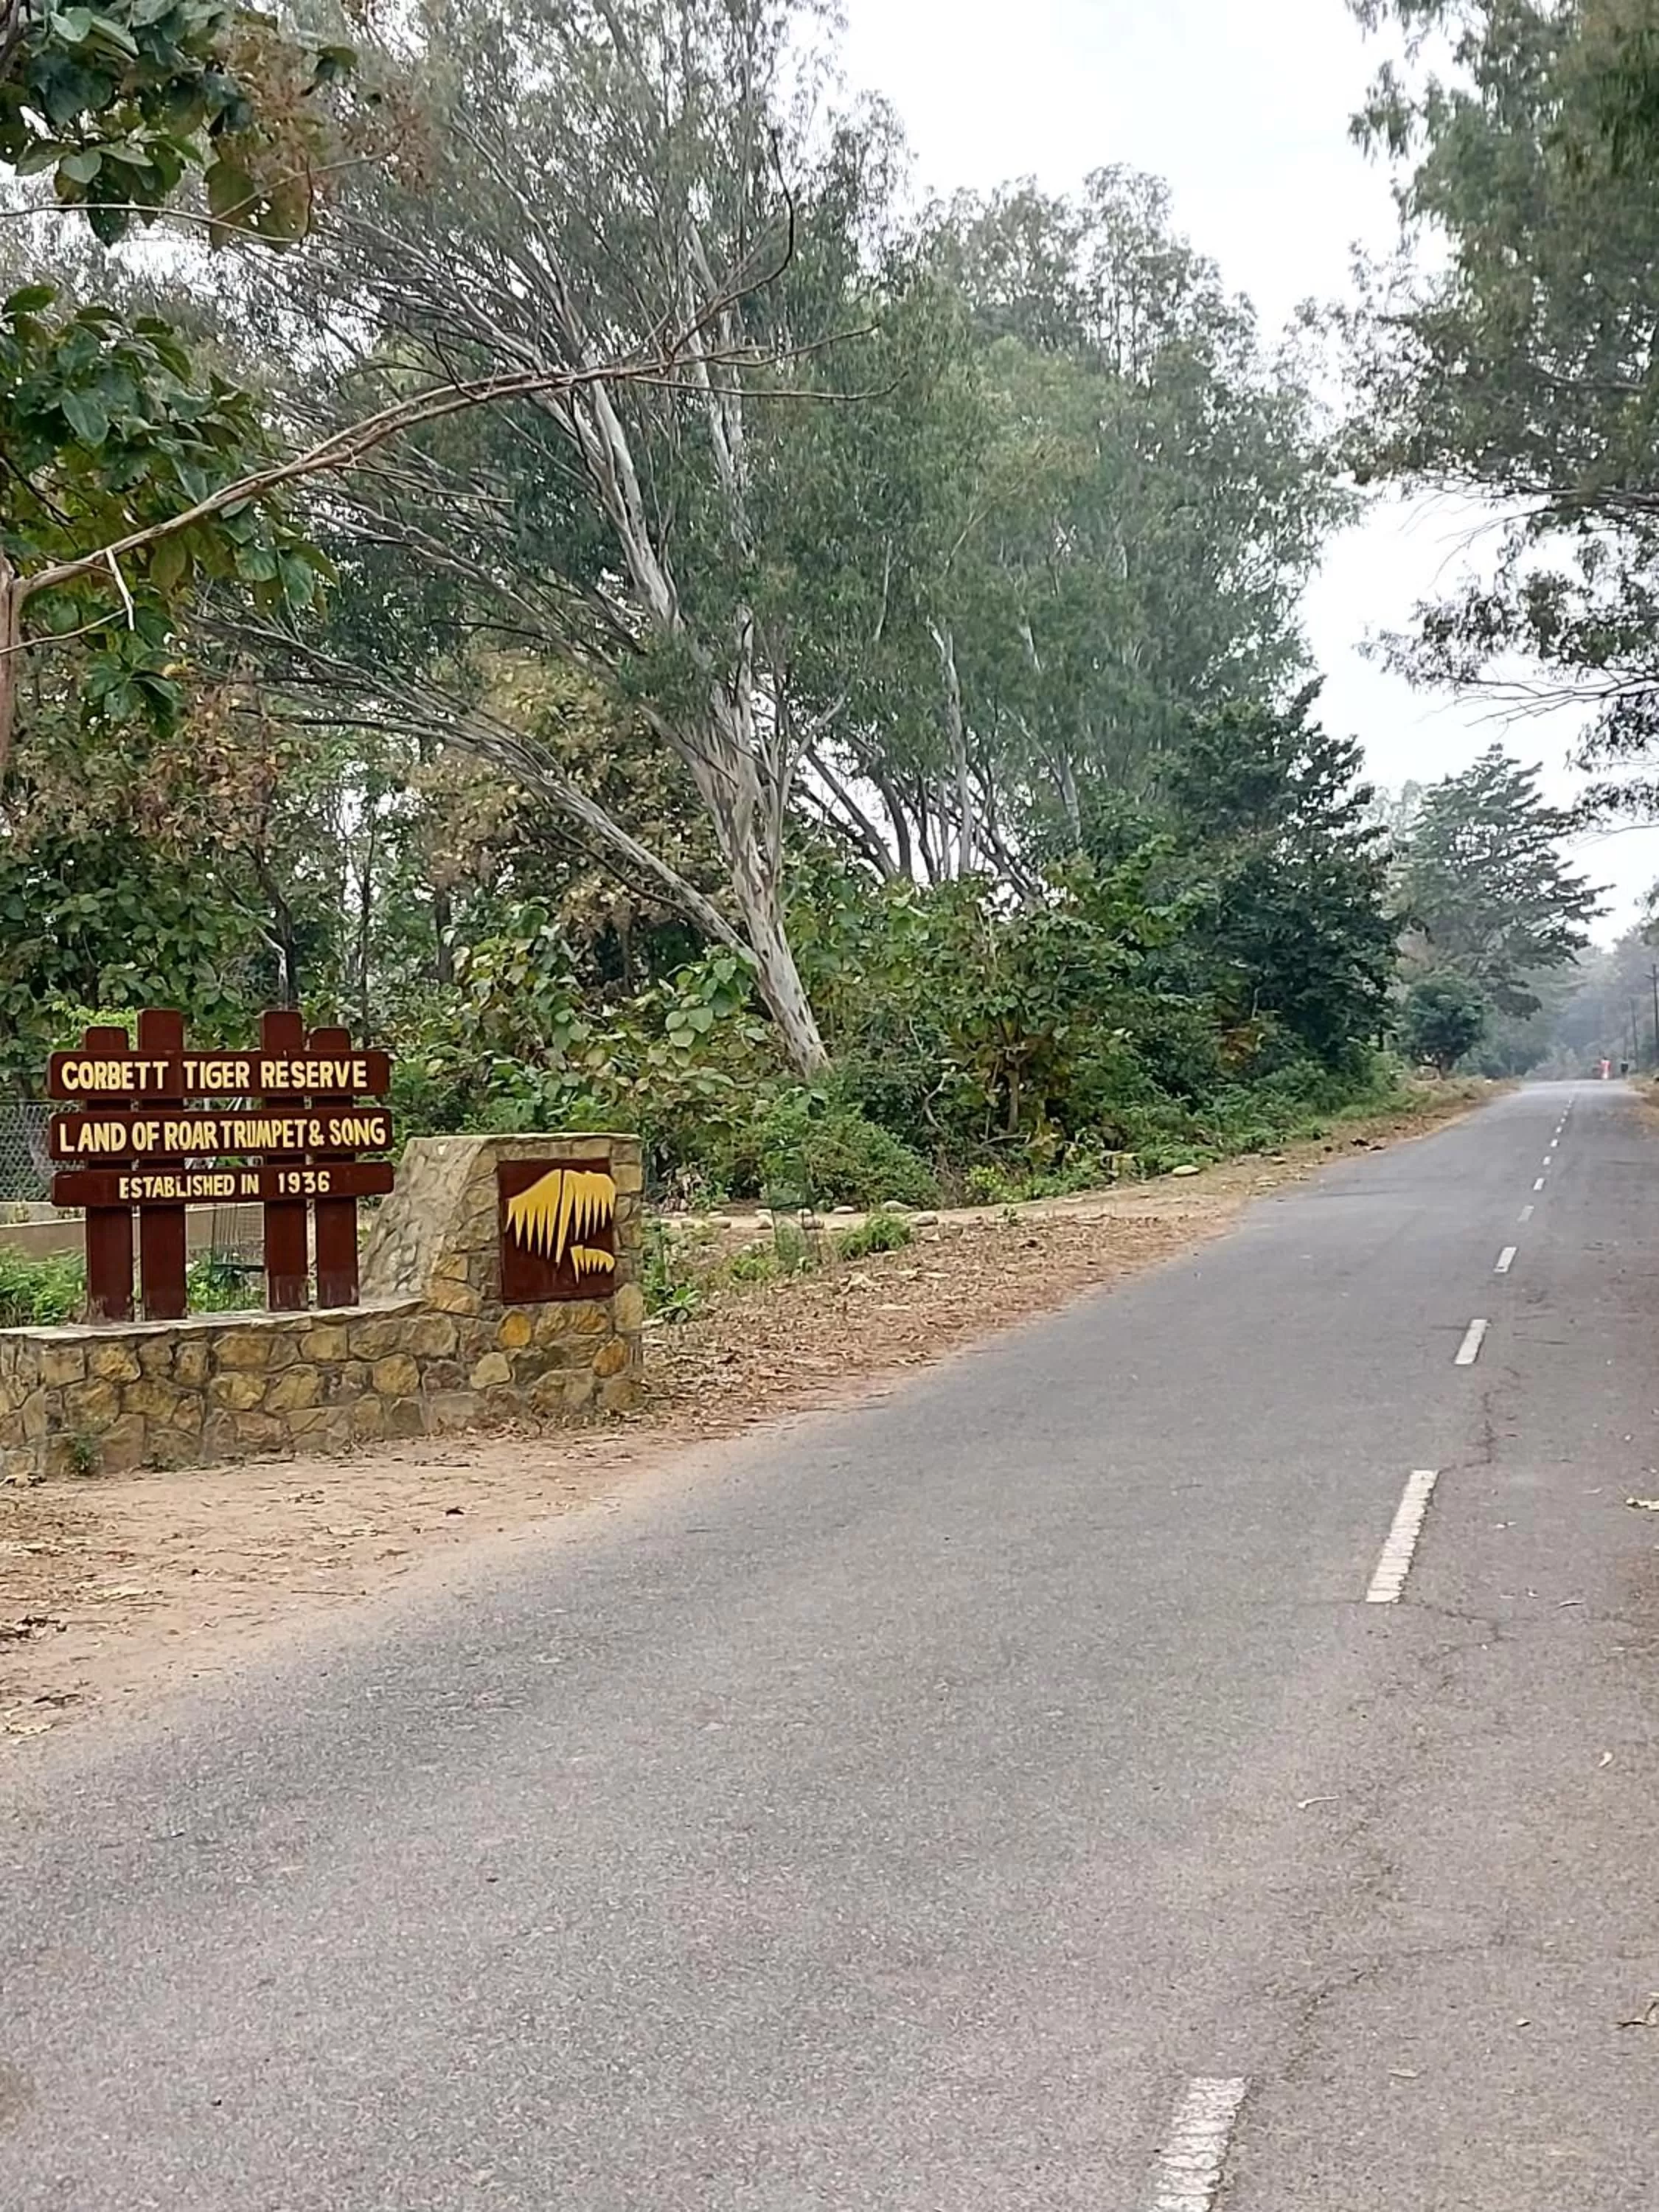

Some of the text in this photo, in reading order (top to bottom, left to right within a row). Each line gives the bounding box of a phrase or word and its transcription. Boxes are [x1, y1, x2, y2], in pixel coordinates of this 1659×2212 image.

[61, 1060, 367, 1090] CORBETT TIGER RESERVE
[59, 1117, 386, 1152] LAND OF ROAR TRUMPET & SONG
[119, 1171, 330, 1200] ESTABLISHED IN 1936
